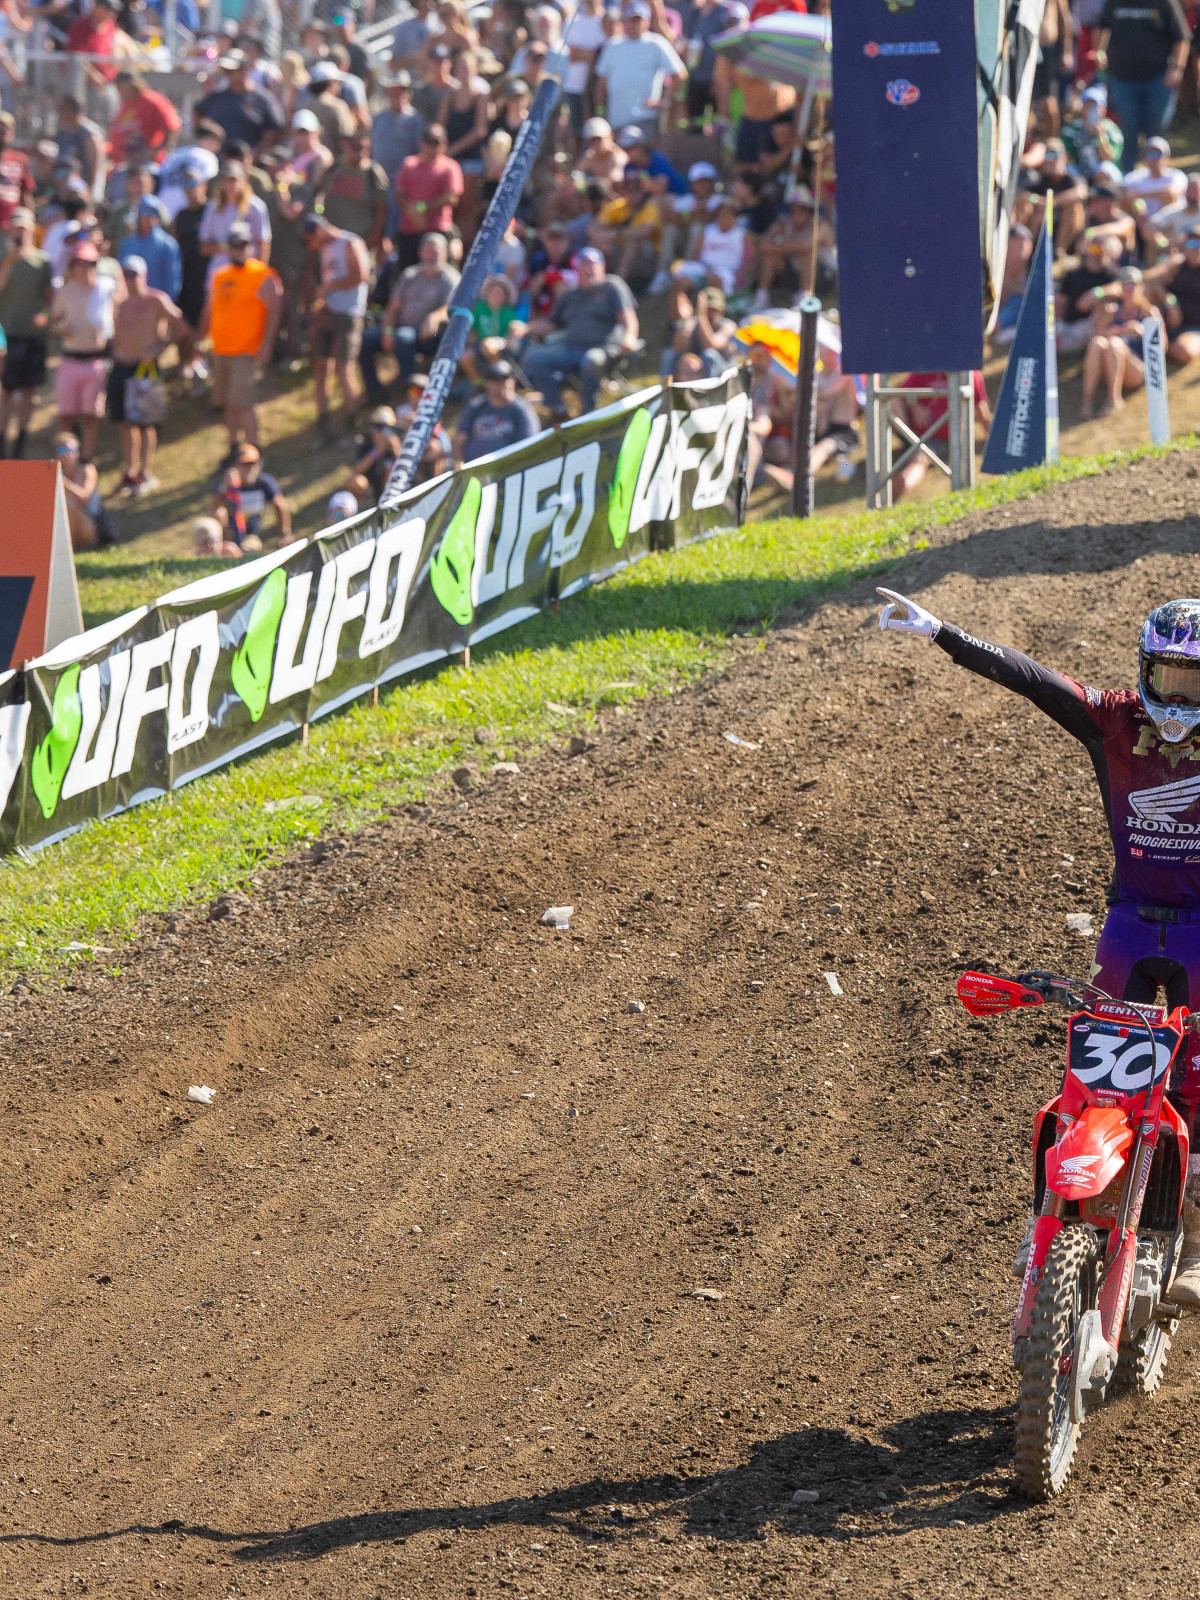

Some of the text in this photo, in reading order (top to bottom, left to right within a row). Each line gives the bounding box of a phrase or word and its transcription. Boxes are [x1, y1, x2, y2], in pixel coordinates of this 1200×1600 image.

[628, 392, 748, 533] UFO
[471, 441, 600, 608] UFO
[269, 517, 426, 704] UFO
[61, 610, 220, 800] UFO
[965, 975, 994, 985] HONDA
[1099, 1004, 1159, 1019] RENTAL
[1071, 1032, 1171, 1090] 30
[1097, 1089, 1124, 1098] HONDA
[1058, 1168, 1097, 1179] HONDA
[1016, 1243, 1037, 1320] DUNLOP
